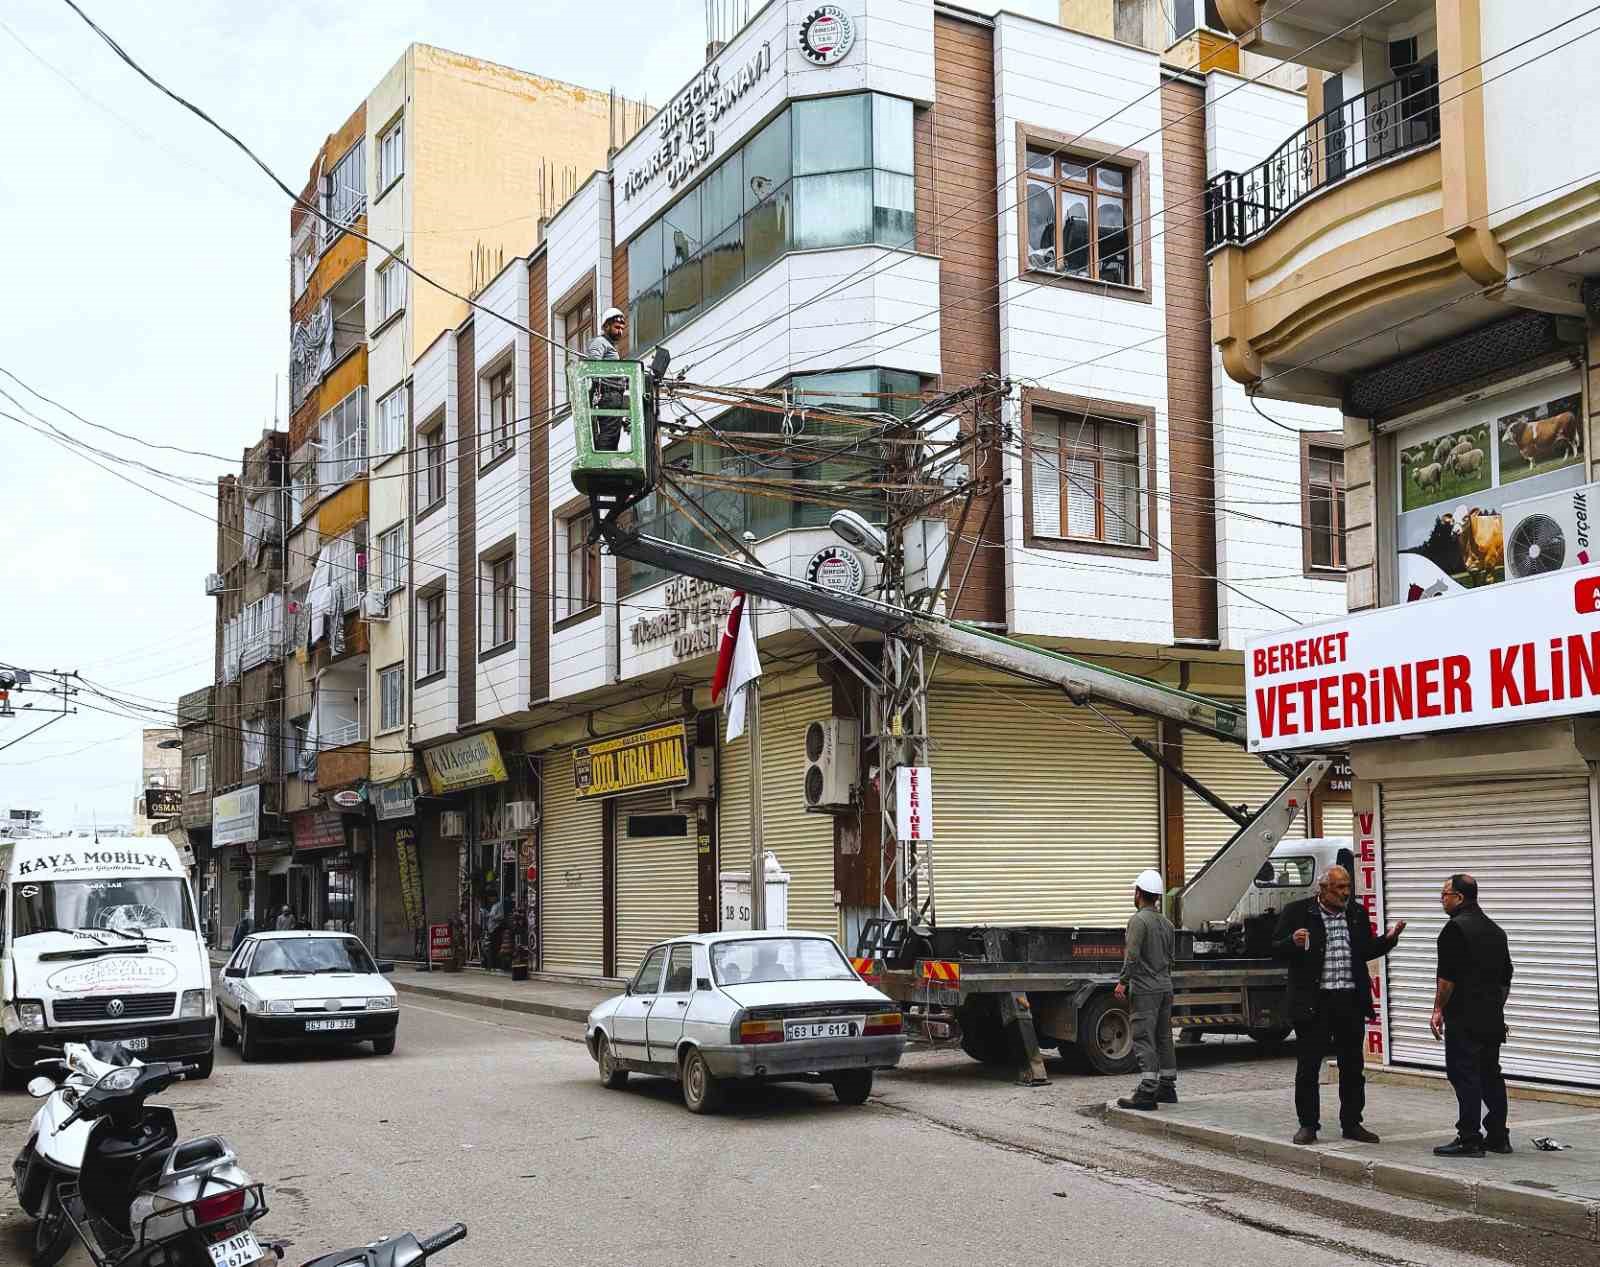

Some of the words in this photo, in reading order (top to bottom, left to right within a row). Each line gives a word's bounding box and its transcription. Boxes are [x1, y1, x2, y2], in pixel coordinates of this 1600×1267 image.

[685, 111, 706, 145] VE
[666, 130, 715, 189] ODASI
[1573, 492, 1590, 548] arçelik
[672, 624, 718, 657] ODASI
[1253, 631, 1349, 677] BEREKET
[19, 853, 76, 876] KAYA
[84, 850, 173, 871] MOBİLYA
[794, 1026, 806, 1038] 63
[811, 1026, 823, 1037] LP
[828, 1024, 847, 1036] 612
[212, 1244, 226, 1259] 27
[228, 1251, 252, 1267] 674
